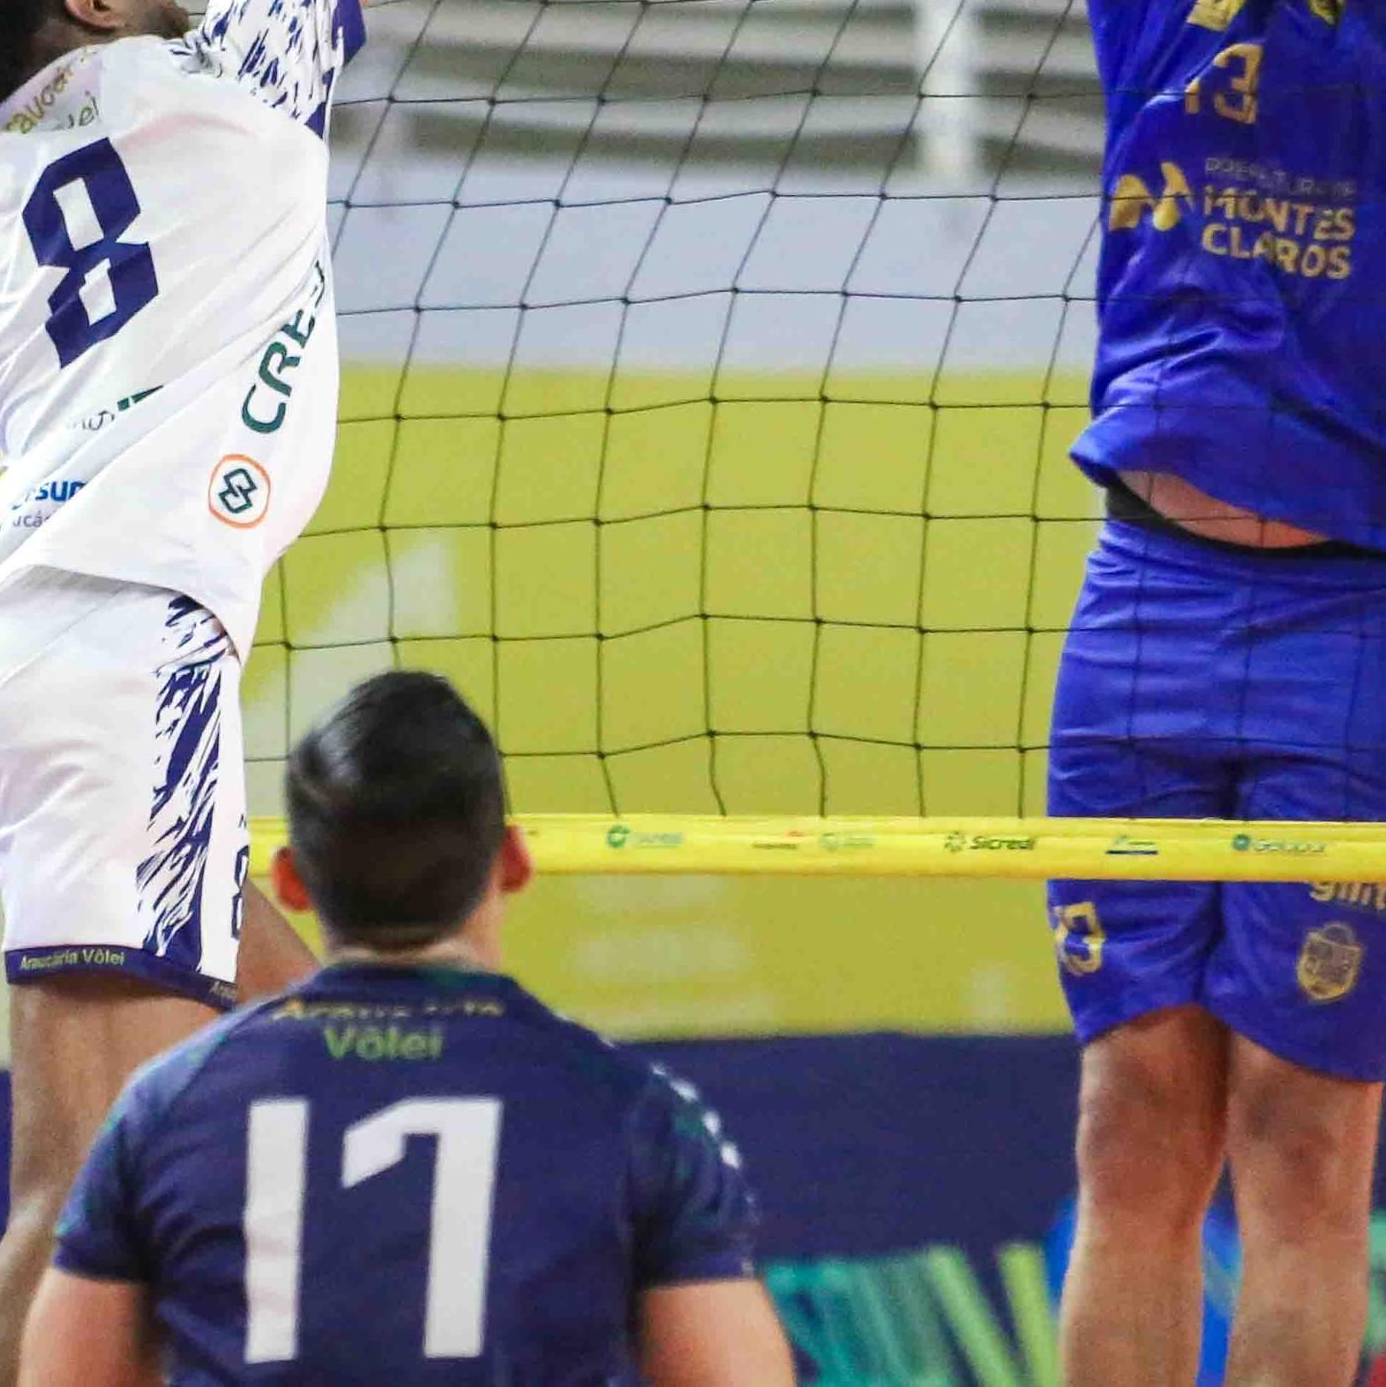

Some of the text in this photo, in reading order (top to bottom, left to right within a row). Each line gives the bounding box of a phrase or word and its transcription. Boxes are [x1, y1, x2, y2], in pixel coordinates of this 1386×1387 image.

[1203, 184, 1356, 242] MONTES
[22, 136, 160, 370] 8
[1201, 222, 1352, 281] CLAROS
[82, 945, 126, 966] Vôlei
[244, 1095, 503, 1365] 17
